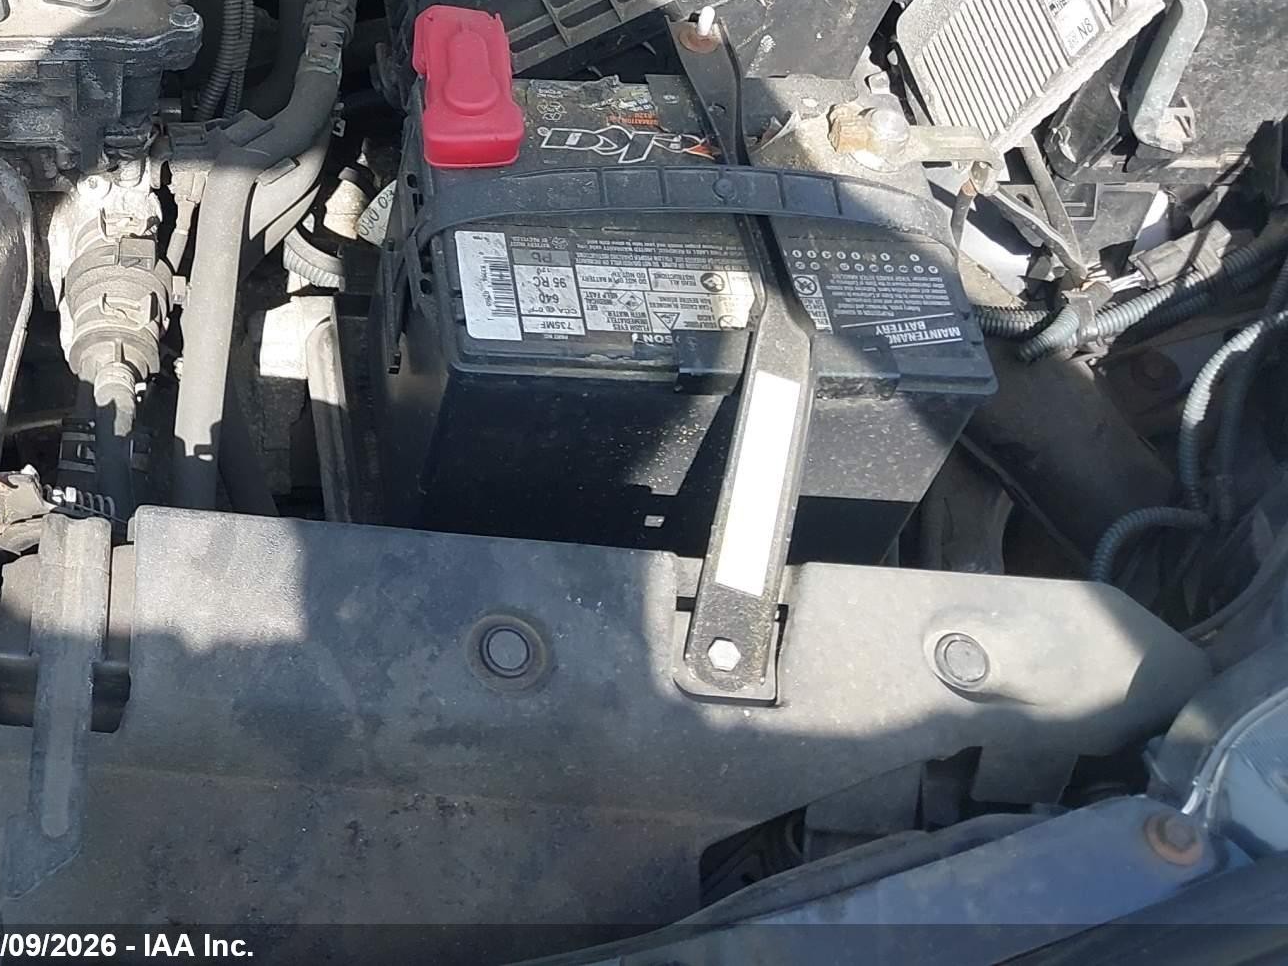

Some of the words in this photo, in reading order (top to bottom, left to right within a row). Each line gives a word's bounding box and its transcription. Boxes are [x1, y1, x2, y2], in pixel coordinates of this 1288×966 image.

[531, 251, 552, 262] Pb
[532, 276, 549, 287] RC
[552, 277, 566, 287] 95
[538, 293, 558, 303] 640
[539, 321, 572, 329] 735MF
[874, 320, 925, 333] BATTERY
[884, 326, 961, 343] MAINTENANC
